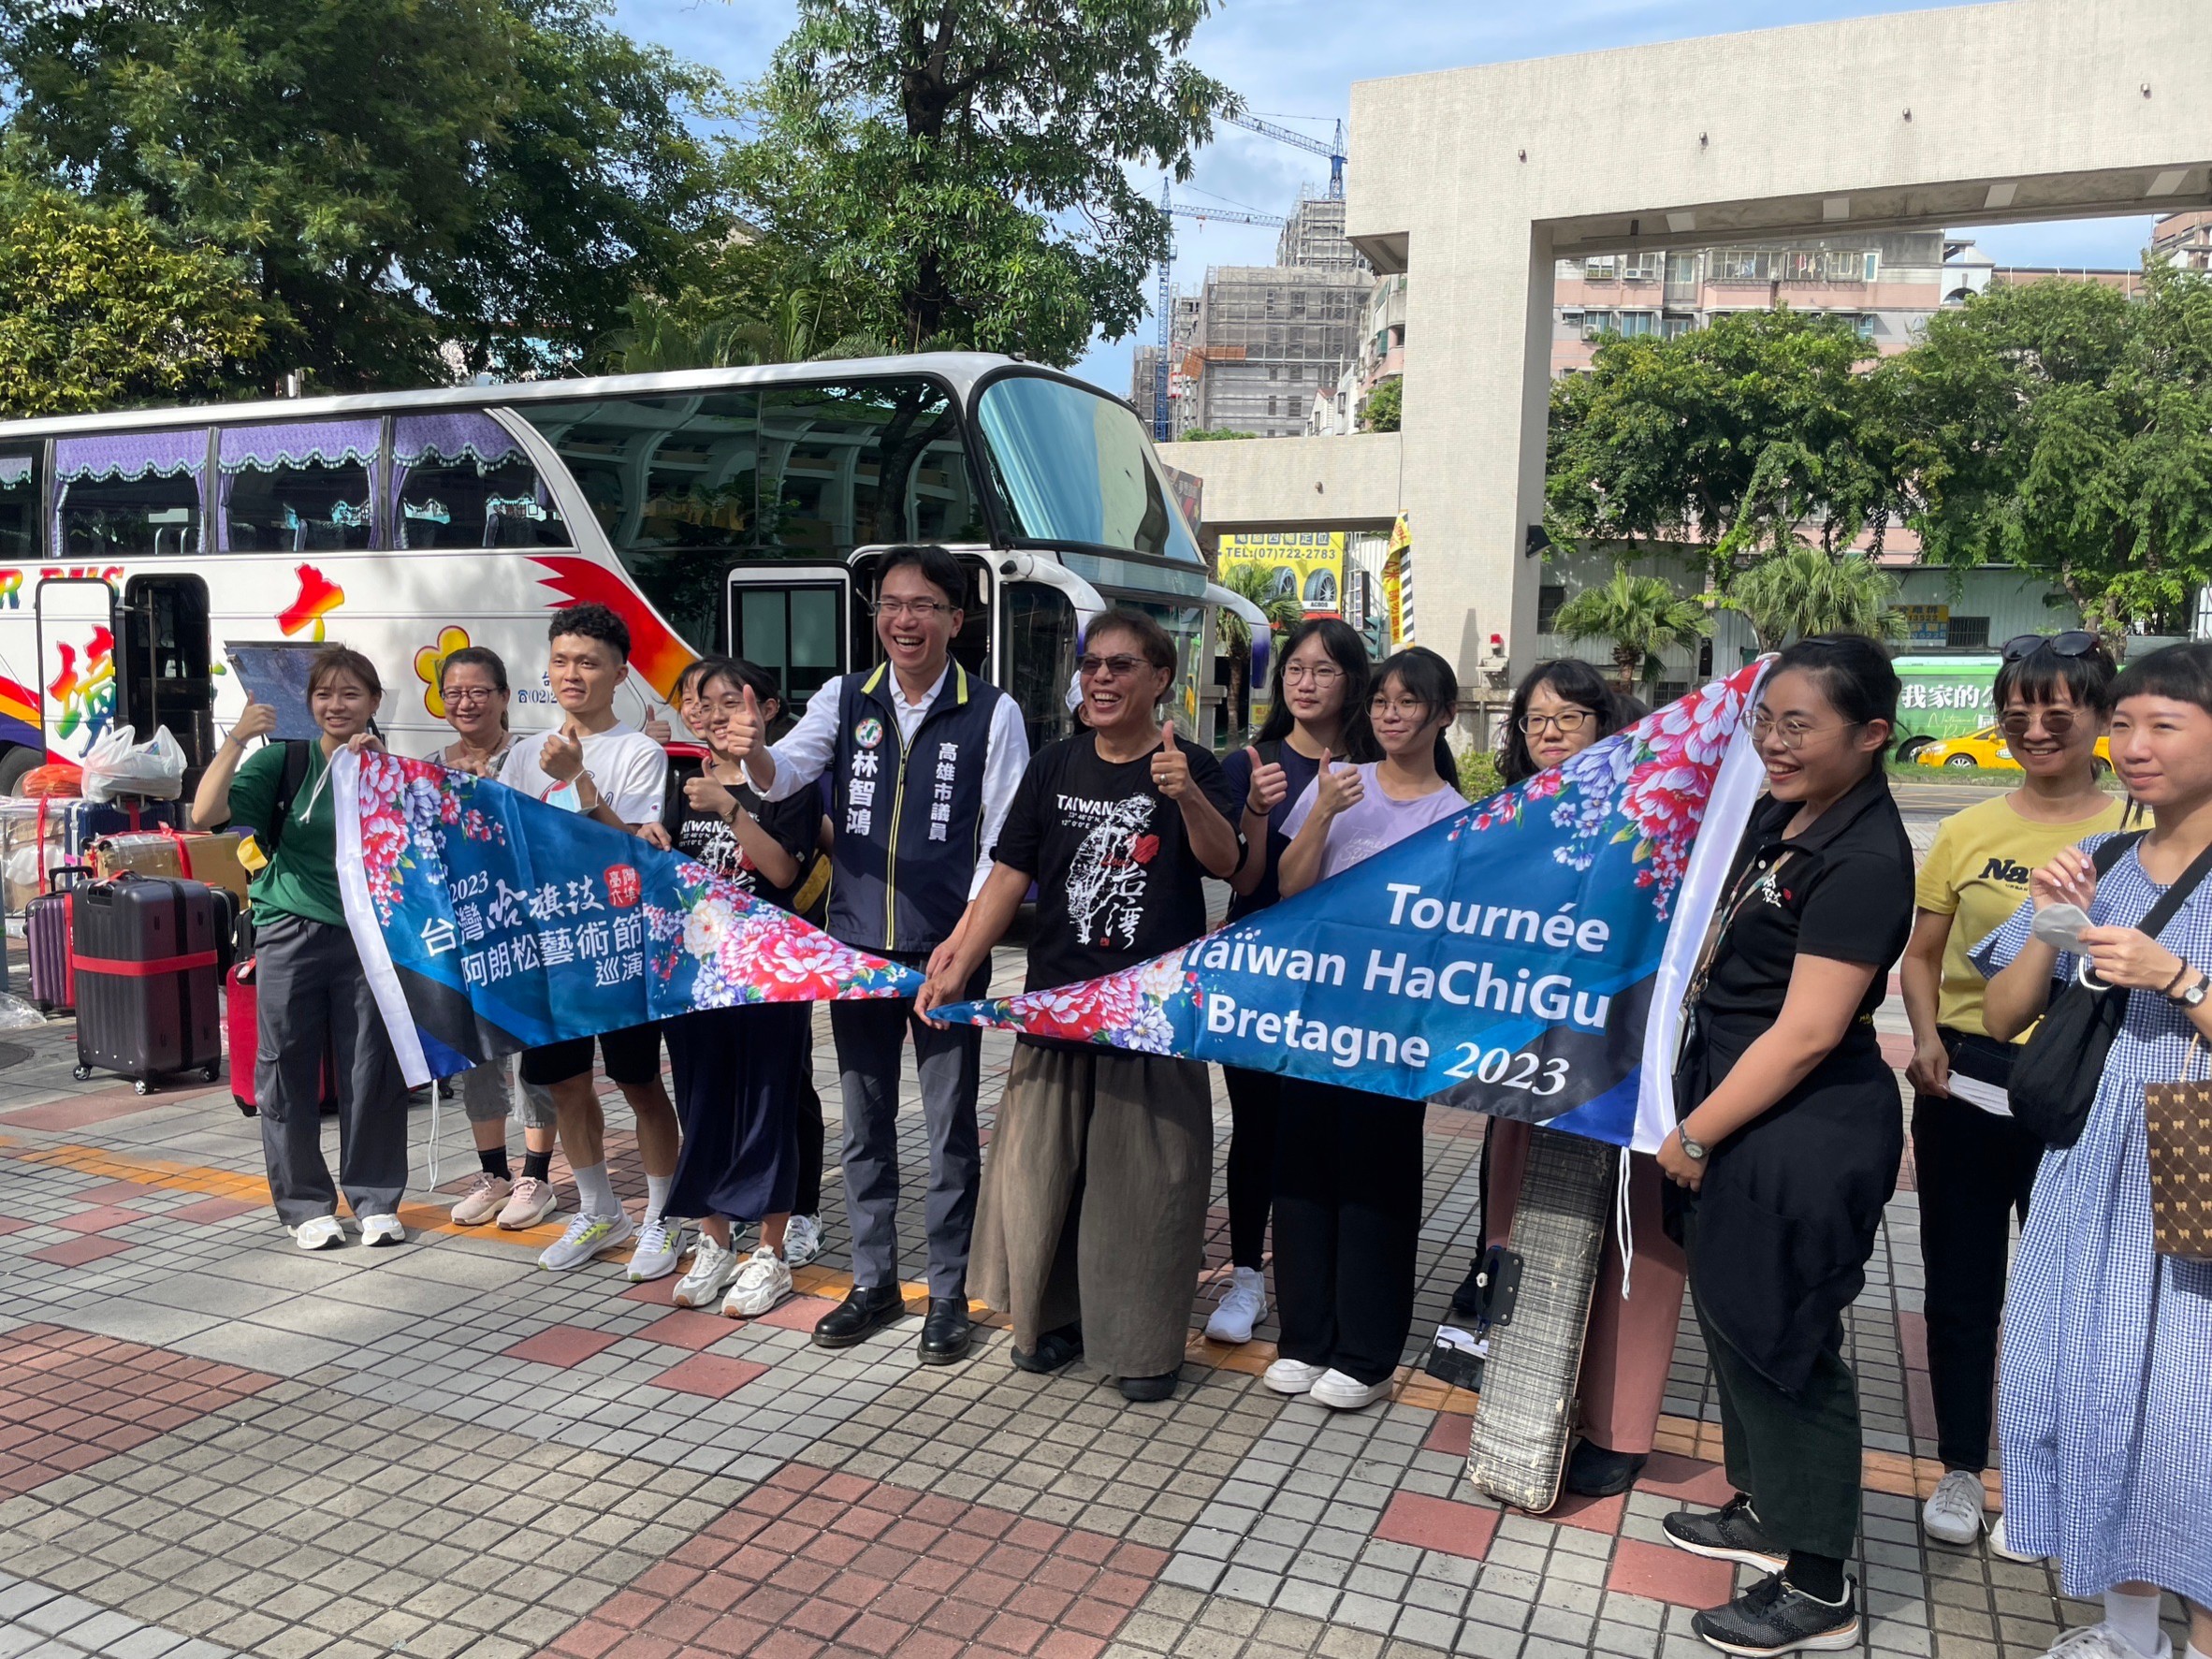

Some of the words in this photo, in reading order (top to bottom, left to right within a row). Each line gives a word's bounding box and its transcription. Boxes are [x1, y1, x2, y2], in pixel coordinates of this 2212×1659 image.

[679, 820, 723, 835] AIWAN
[845, 749, 879, 836] 林智鴻
[928, 742, 958, 842] 高雄市議員
[1056, 793, 1114, 817] TAIWAN
[450, 870, 488, 903] 2023
[1978, 857, 2034, 884] Na
[460, 910, 643, 990] 阿朗松藝術節
[1386, 882, 1610, 953] Tournée
[595, 951, 644, 988] 巡演
[1362, 949, 1611, 1029] HaChiGu
[1207, 994, 1430, 1068] Bretagne
[1443, 1041, 1571, 1096] 2023
